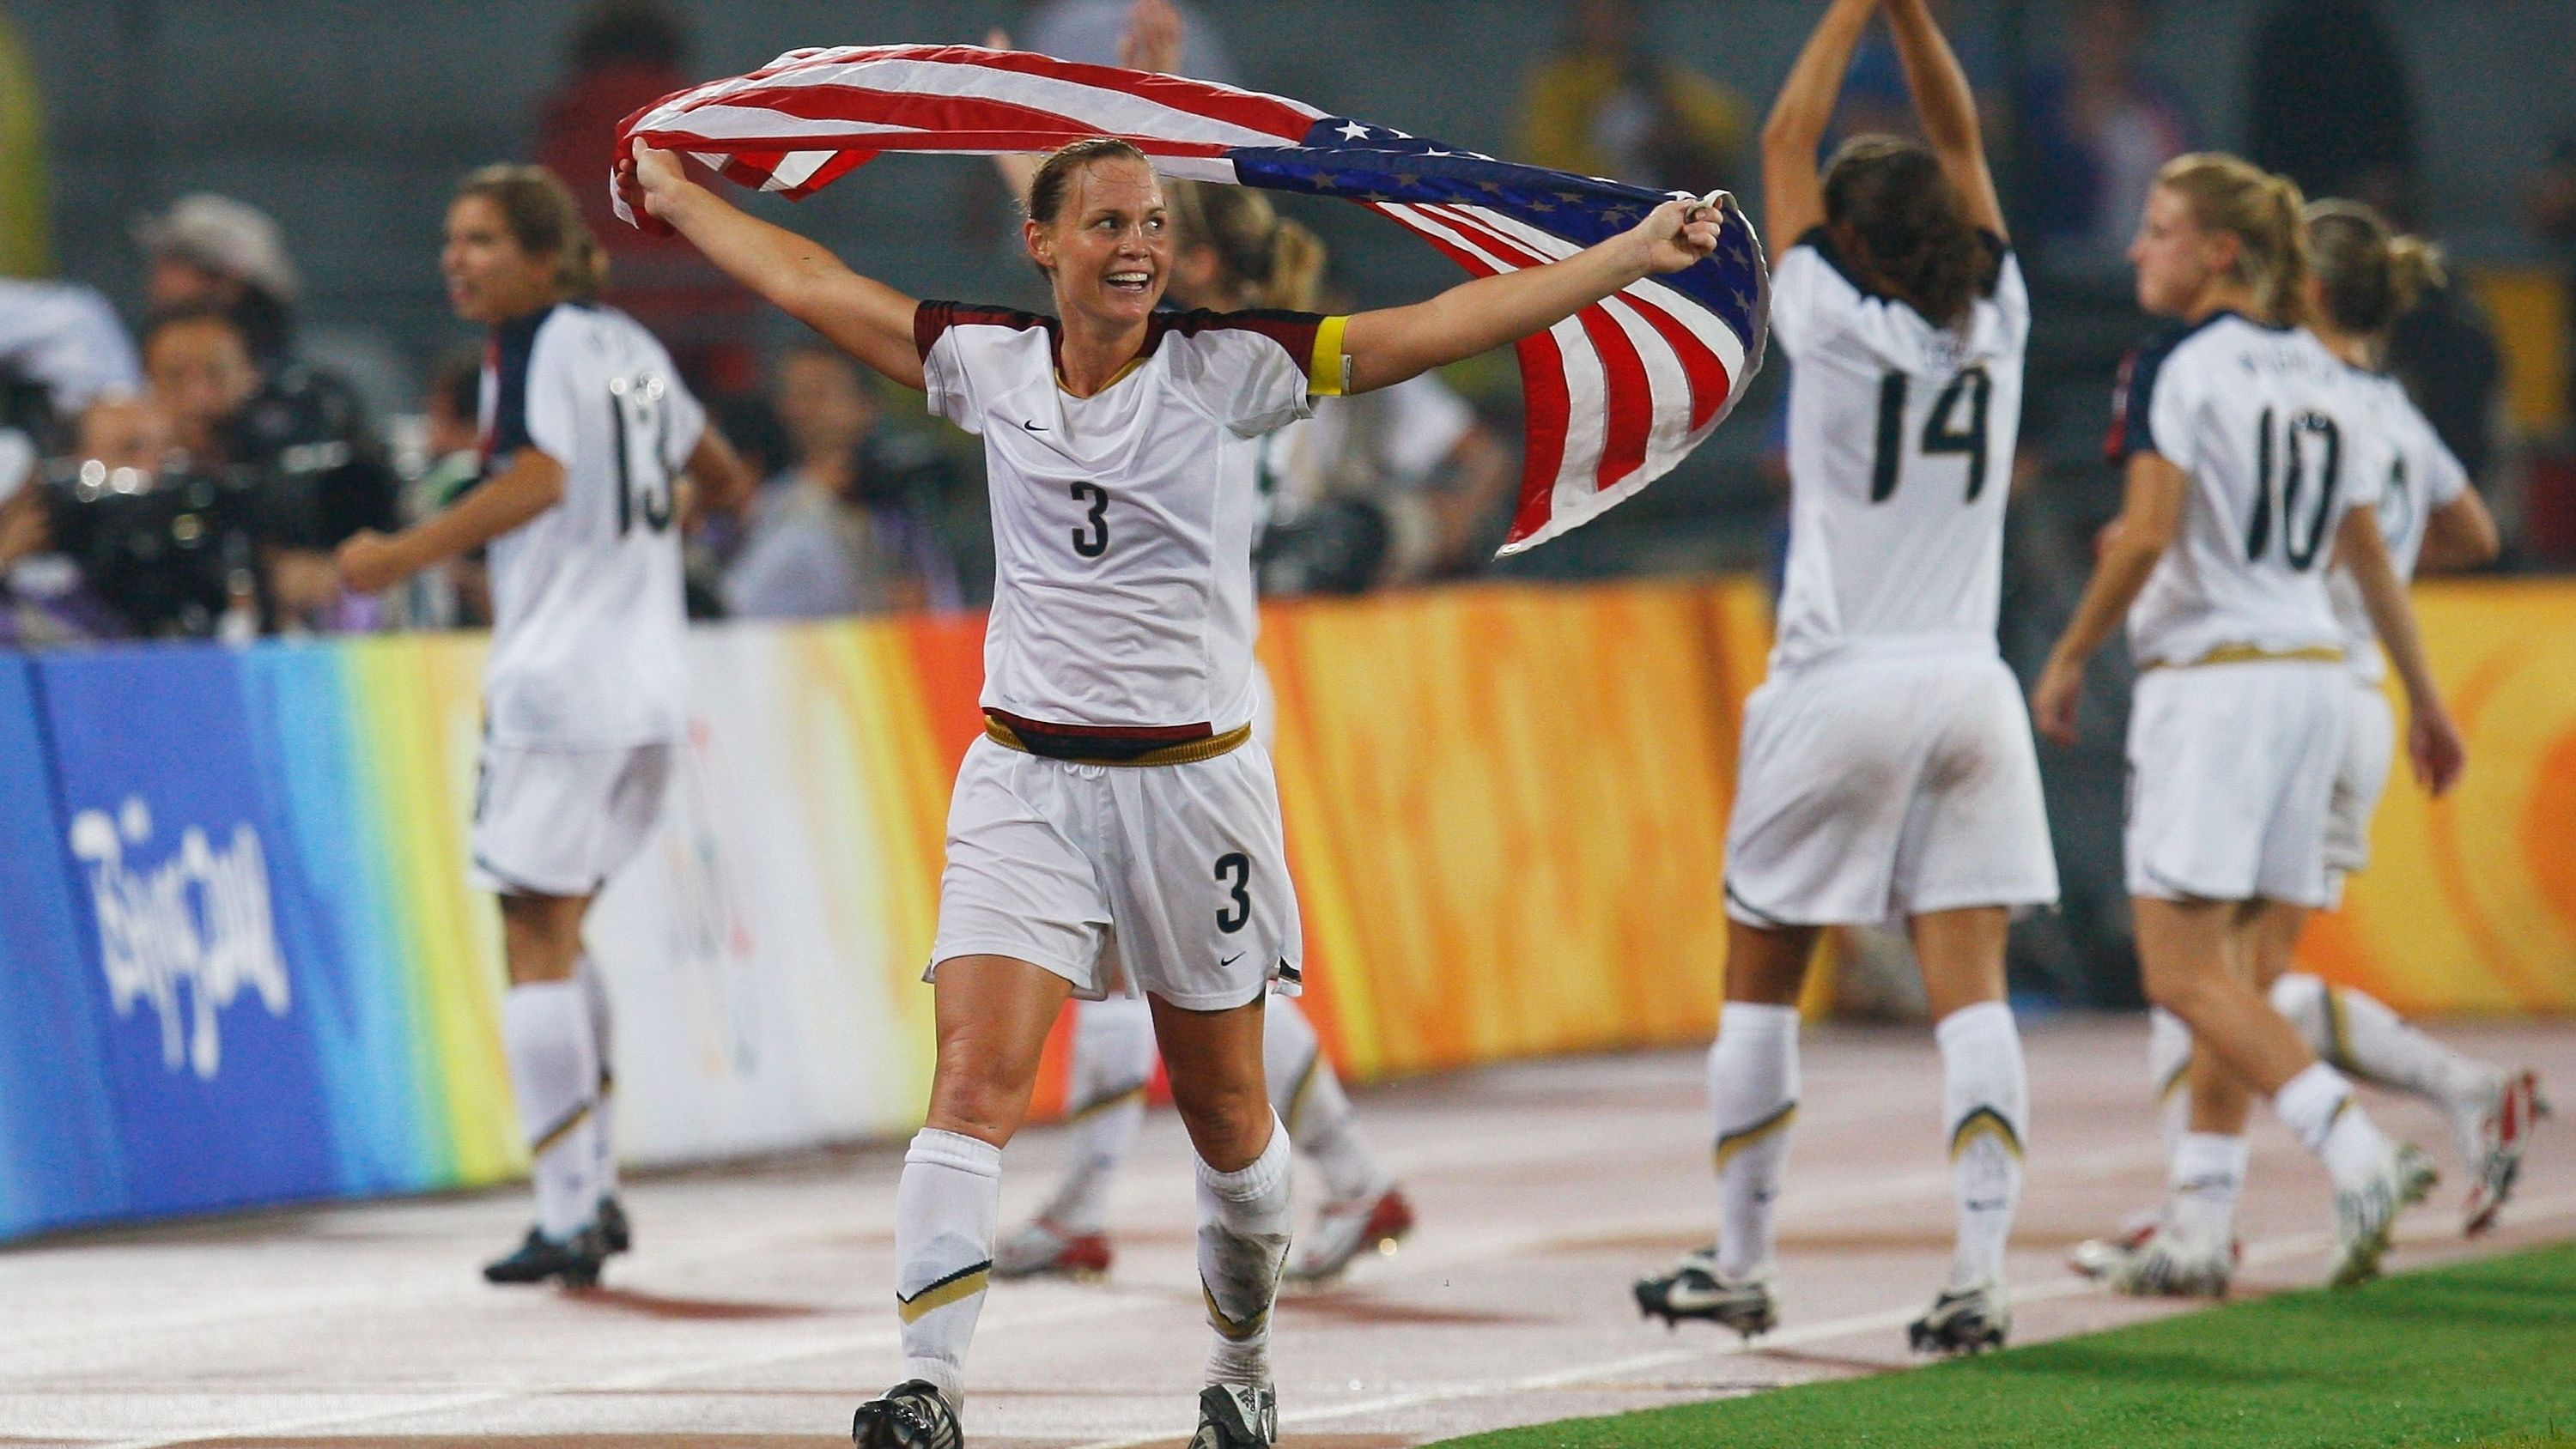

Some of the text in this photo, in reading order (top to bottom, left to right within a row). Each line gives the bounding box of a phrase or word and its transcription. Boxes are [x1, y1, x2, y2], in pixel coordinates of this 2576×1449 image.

[609, 373, 673, 536] 13
[1871, 367, 1992, 504] 14
[2246, 405, 2340, 572] 10
[1069, 481, 1109, 557] 3
[1213, 852, 1251, 935] 3
